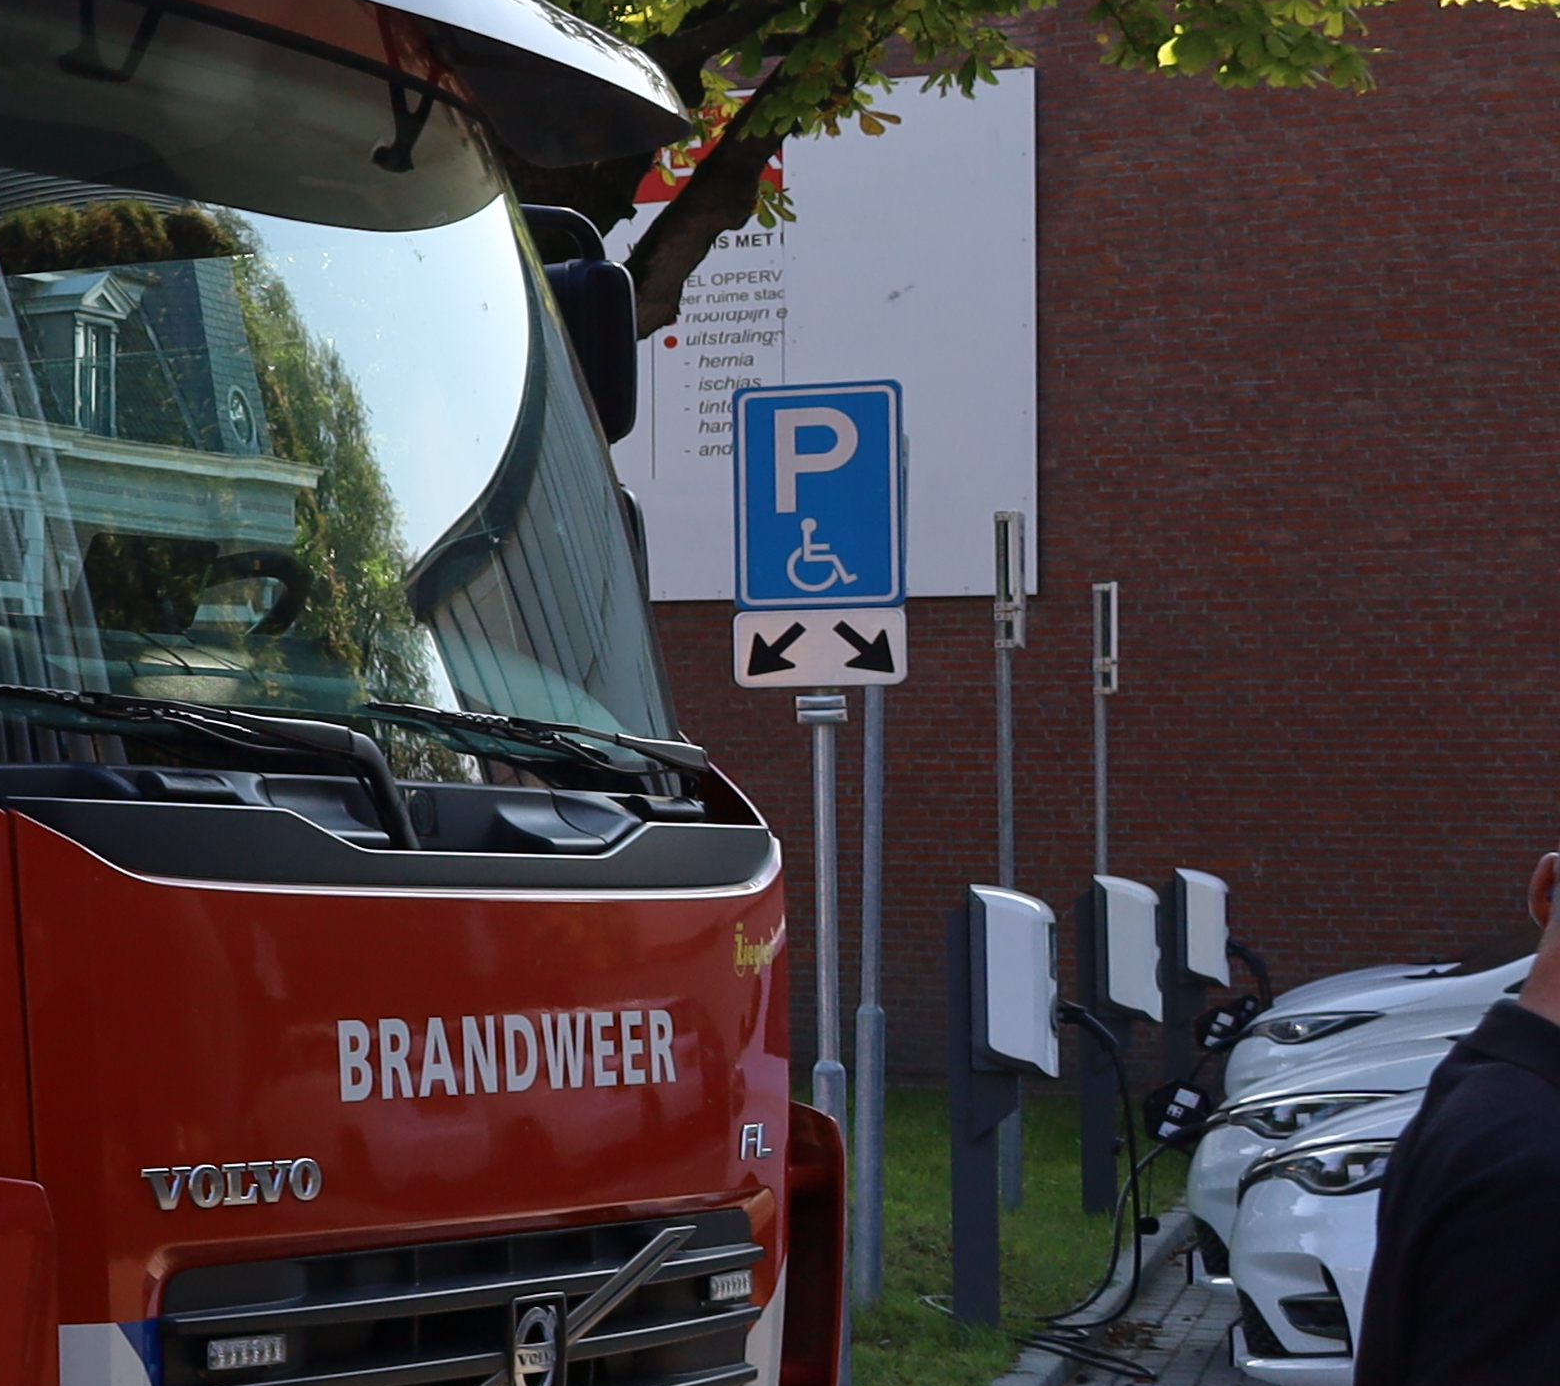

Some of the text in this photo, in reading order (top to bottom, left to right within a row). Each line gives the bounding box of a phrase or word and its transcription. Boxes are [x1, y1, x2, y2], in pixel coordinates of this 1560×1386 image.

[735, 233, 773, 248] MET
[706, 289, 749, 304] ruime
[698, 354, 754, 369] hernia
[698, 376, 762, 392] ischias
[774, 406, 858, 513] P
[338, 1009, 677, 1102] BRANDWEER
[740, 1122, 774, 1161] FL
[141, 1158, 322, 1211] VOLVO
